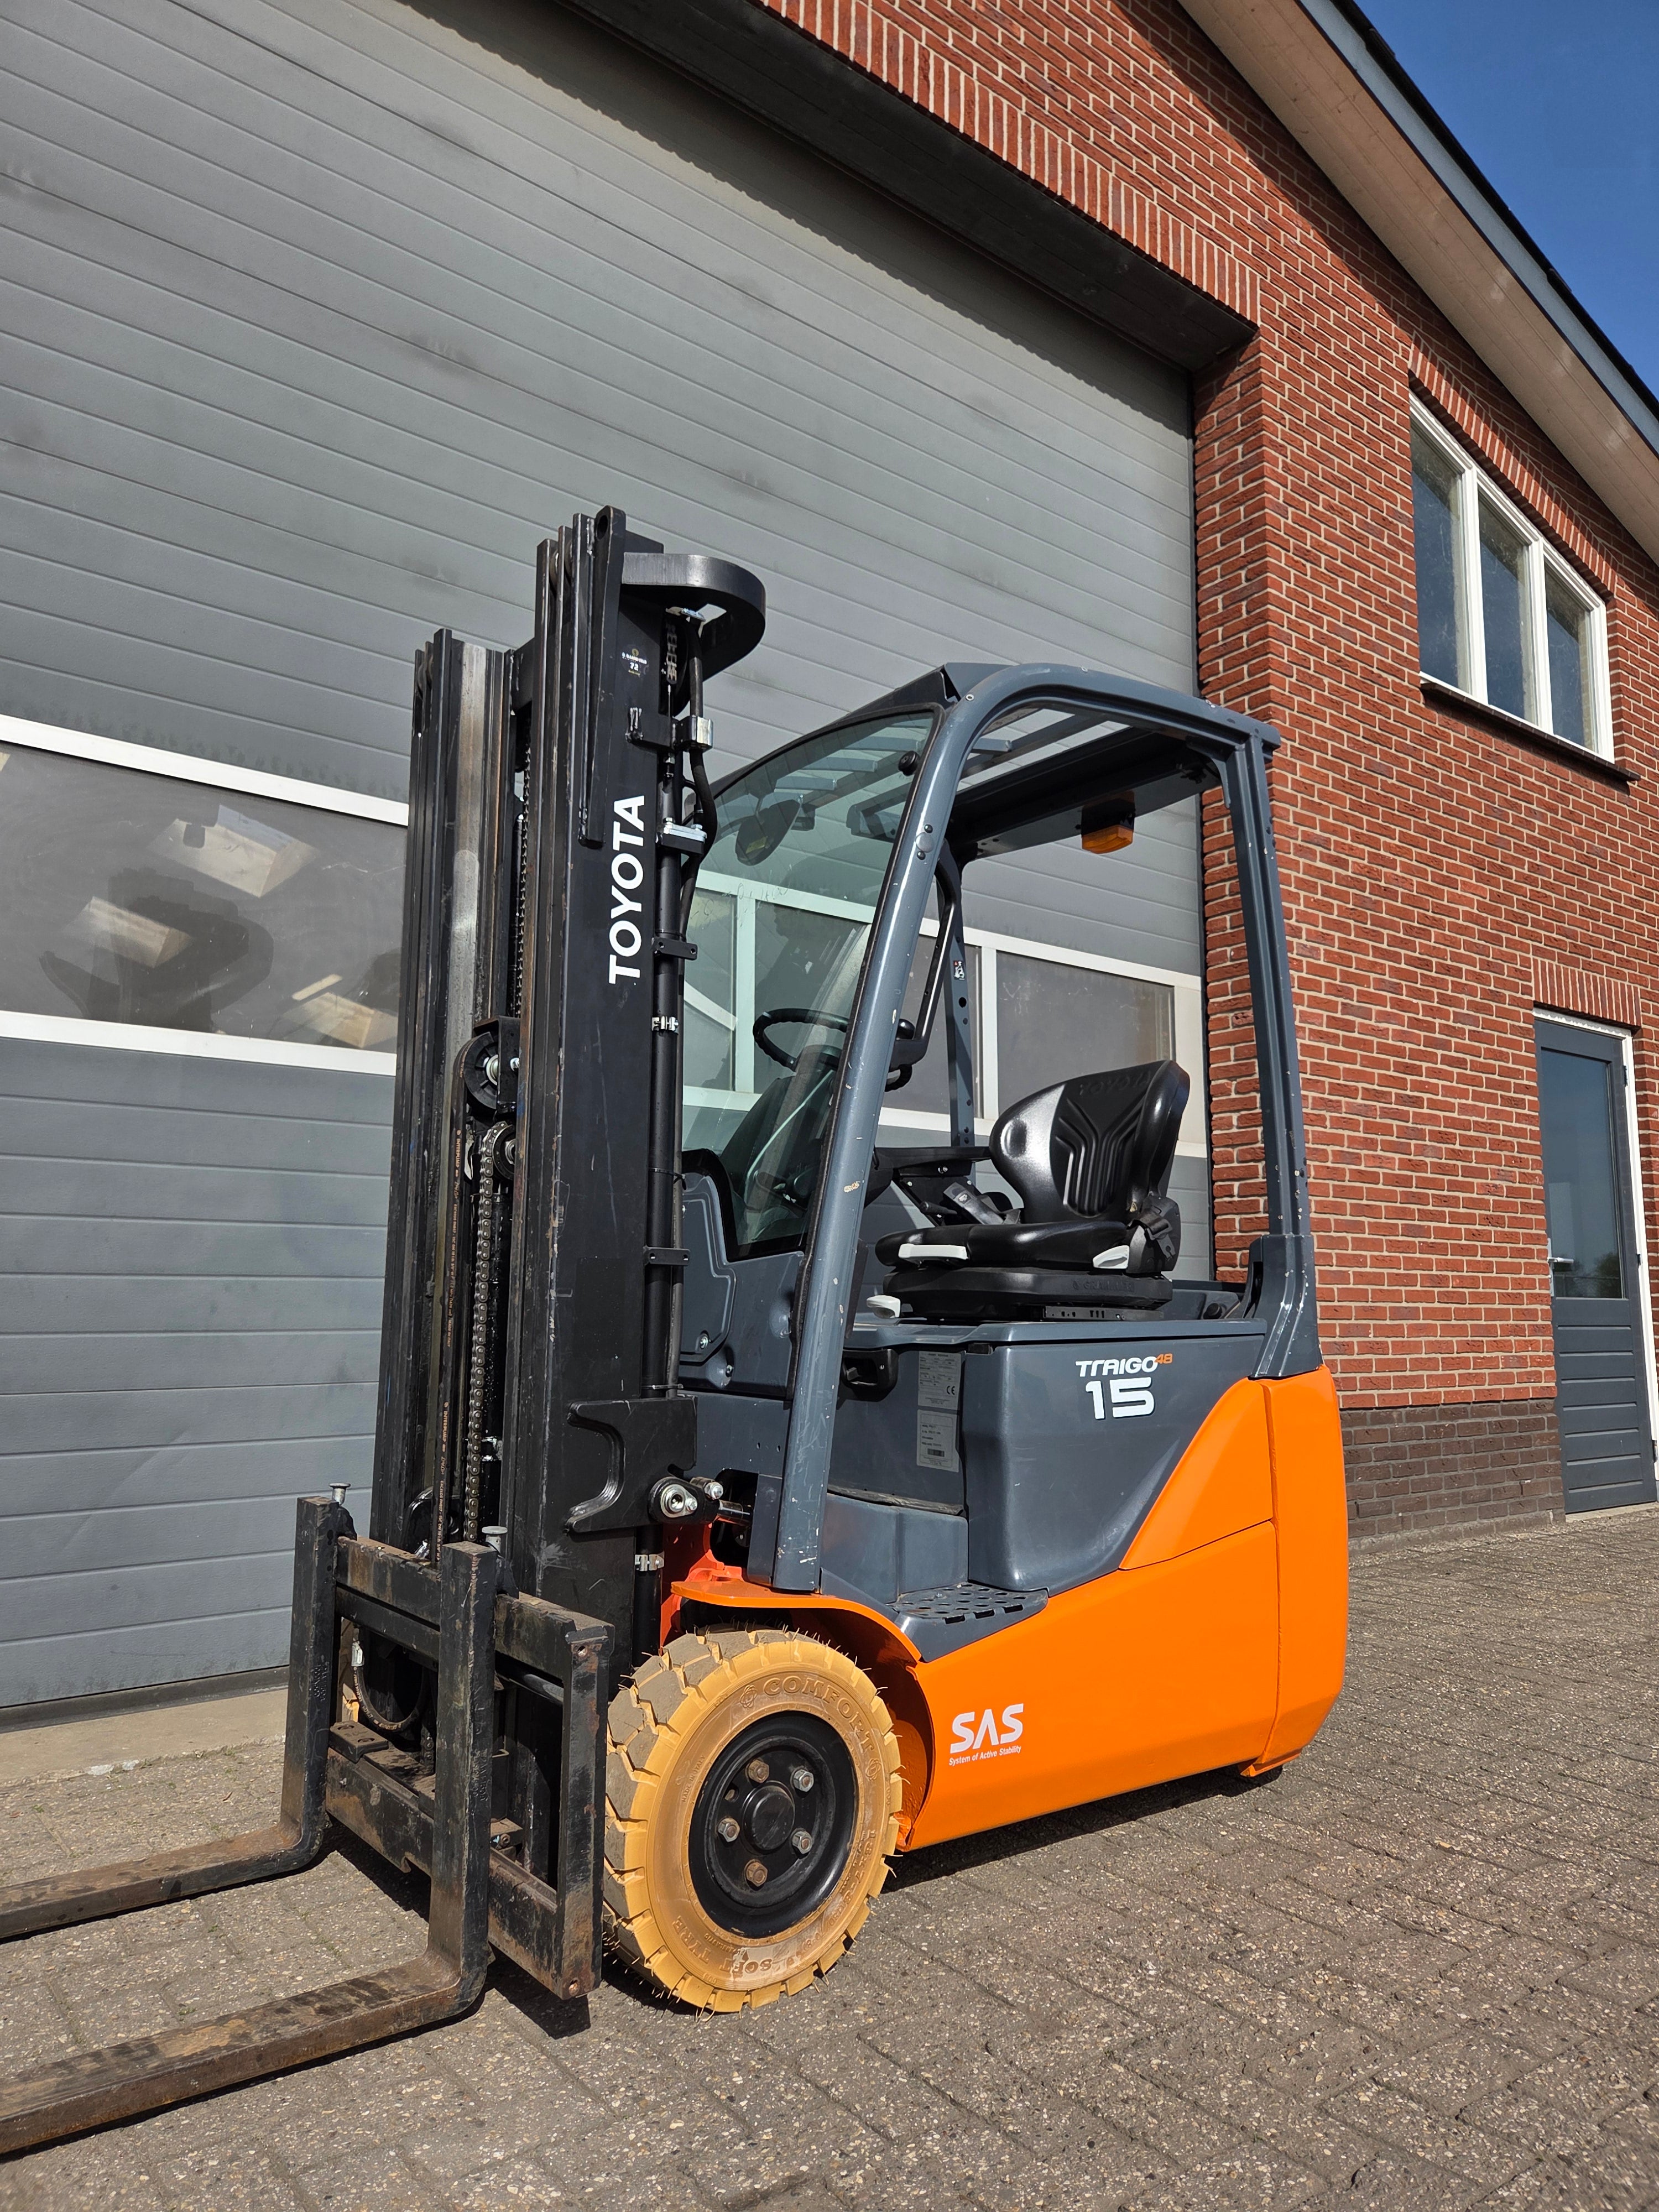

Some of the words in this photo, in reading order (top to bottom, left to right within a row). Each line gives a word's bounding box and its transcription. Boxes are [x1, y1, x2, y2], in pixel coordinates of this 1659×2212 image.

[629, 661, 638, 671] 72
[609, 795, 645, 984] TOYOTA
[1076, 1356, 1158, 1377] TRAIGO
[1155, 1353, 1173, 1364] 48
[1086, 1377, 1154, 1419] 15
[763, 1674, 876, 1754] COMFORT
[950, 1703, 1024, 1754] SAS
[949, 1756, 971, 1767] System
[972, 1752, 978, 1761] of
[979, 1751, 997, 1760] Active
[999, 1745, 1021, 1756] Stability
[672, 1914, 712, 1965] TYRE
[717, 1953, 772, 1978] SOFT
